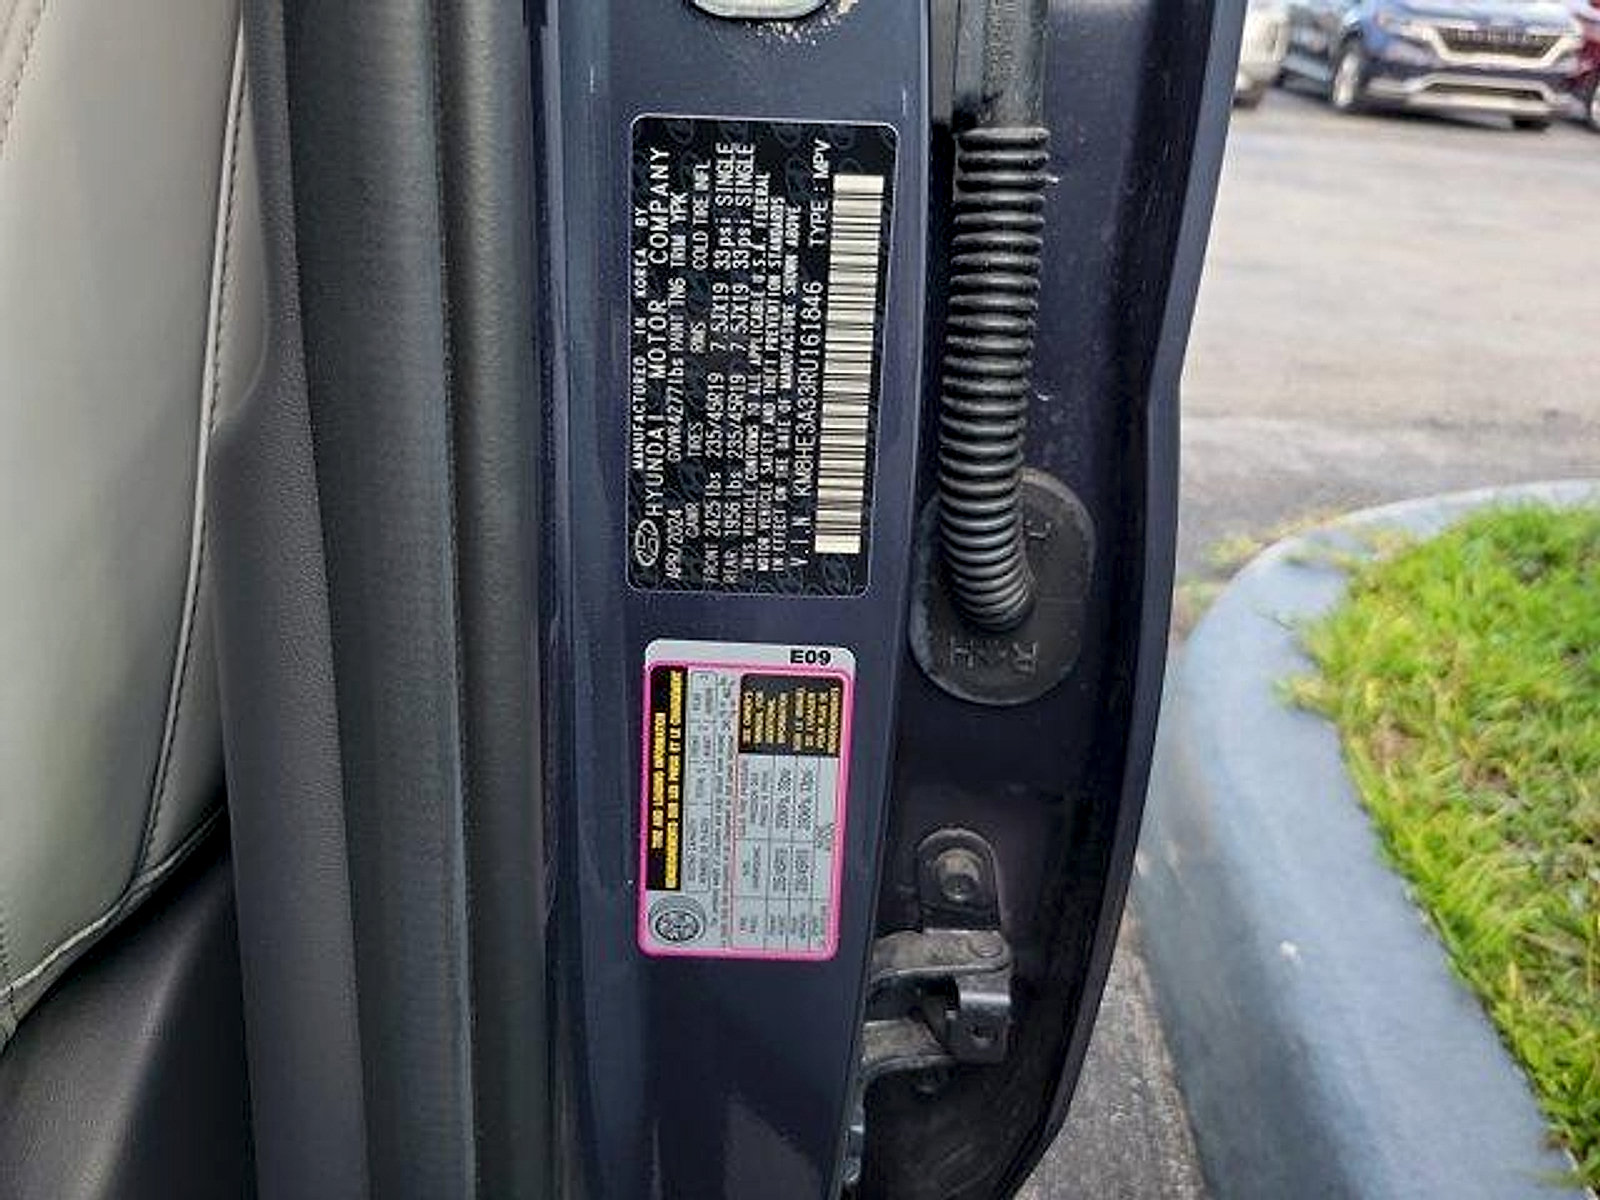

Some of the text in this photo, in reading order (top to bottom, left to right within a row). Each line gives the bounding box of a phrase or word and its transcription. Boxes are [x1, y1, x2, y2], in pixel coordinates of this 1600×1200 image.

[716, 142, 734, 206] SINGLE
[735, 144, 754, 206] SINGLE
[813, 139, 831, 179] MPV
[671, 191, 688, 223] YPK
[694, 197, 709, 225] TIRE
[755, 172, 770, 228] FEDERAL
[769, 197, 785, 267] STANDARDS
[786, 205, 801, 247] ABOVE
[809, 201, 827, 247] TYPE
[671, 235, 686, 267] TRIM
[693, 231, 709, 270] COLD
[645, 146, 669, 516] HYUNDAI MOTOR COMPANY
[670, 315, 684, 351] PAINT
[766, 275, 782, 351] PREVENTION
[633, 206, 648, 470] MANUFACTURED IN KOREA BY
[749, 373, 762, 395] ALL
[764, 359, 777, 394] THEFT
[794, 281, 821, 496] KM8HE3A33RU161846
[707, 373, 724, 458] 235/45R19
[727, 375, 746, 459] 235/45R19
[688, 421, 703, 457] TIRES
[762, 432, 775, 474] SAFETY
[776, 458, 789, 478] THE
[745, 489, 758, 536] VEHICLE
[773, 509, 787, 551] EFFECT
[666, 509, 683, 579] APR/2024
[705, 543, 719, 583] FRONT
[723, 550, 738, 583] REAR
[790, 648, 831, 665] E09
